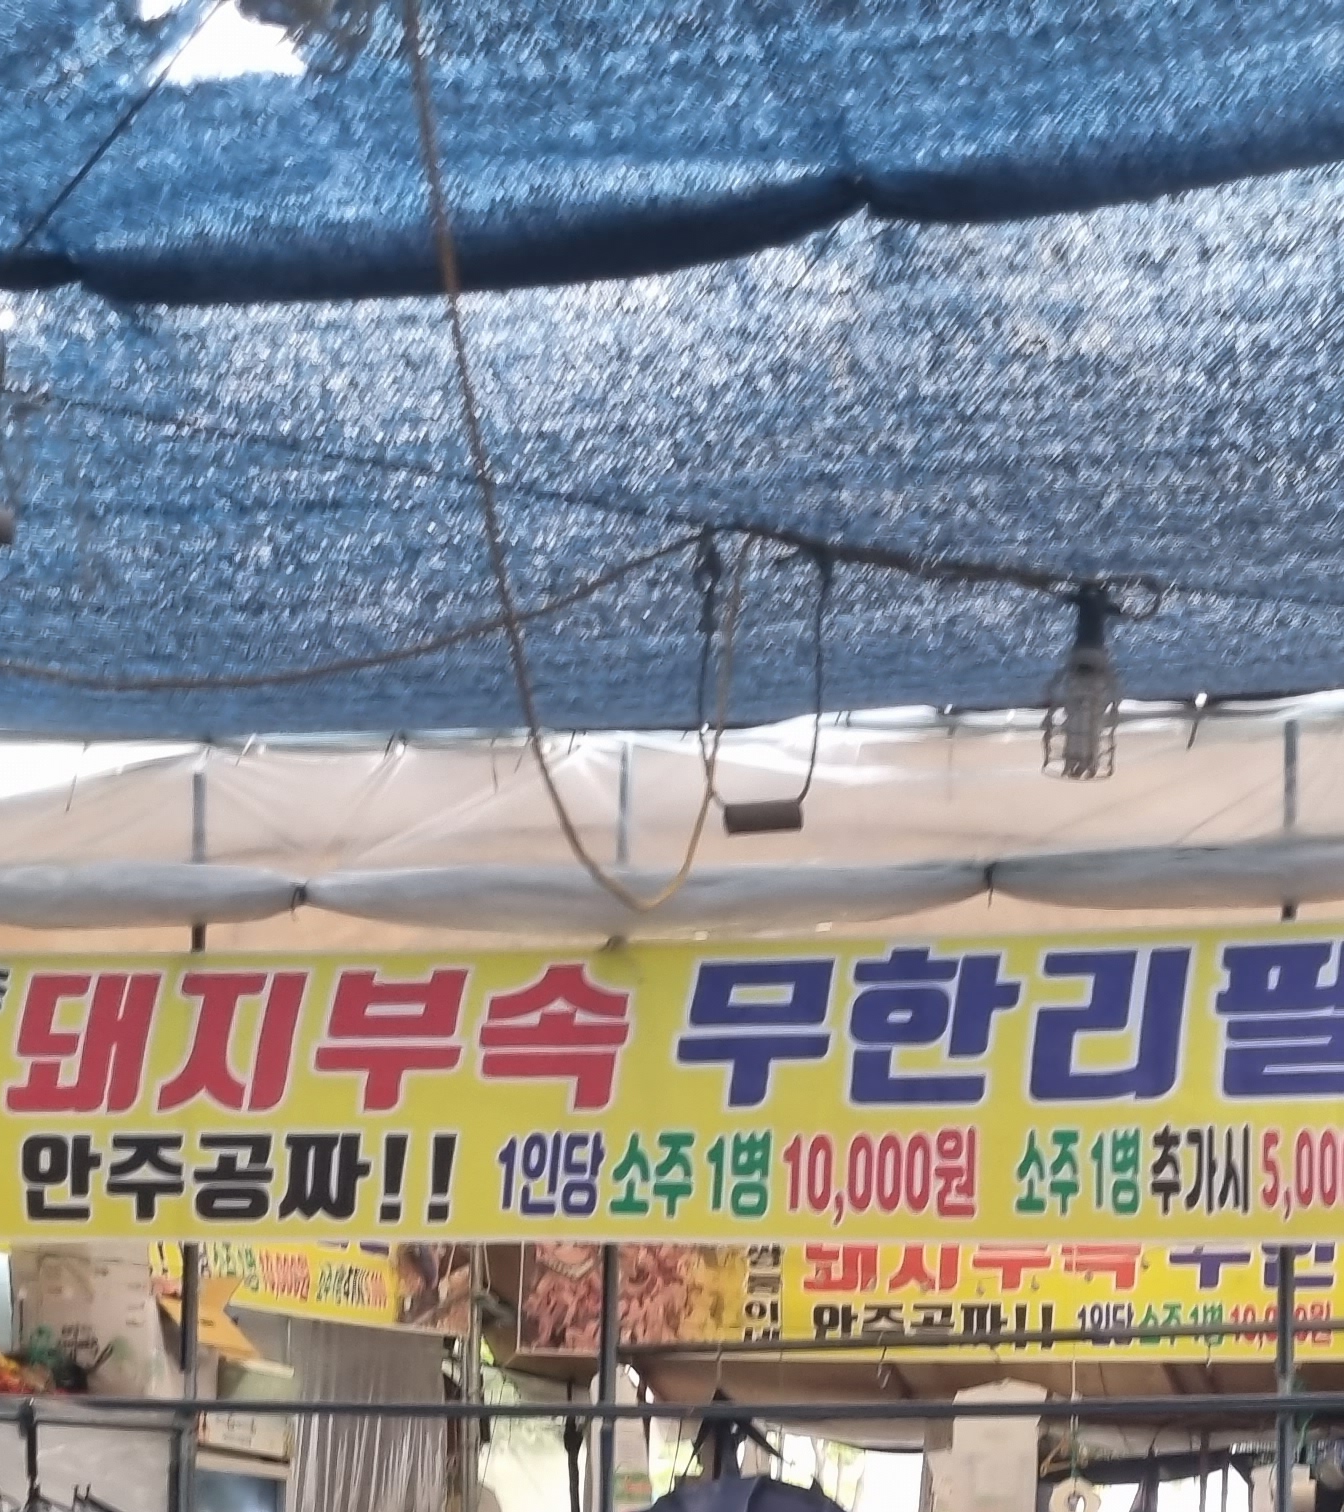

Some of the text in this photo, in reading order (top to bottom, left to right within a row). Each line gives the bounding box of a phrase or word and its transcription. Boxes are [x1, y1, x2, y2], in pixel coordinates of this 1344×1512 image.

[6, 963, 630, 1114] 돼지부속
[21, 1132, 457, 1222] 안주공짜!!
[498, 1130, 605, 1217] 1인당
[609, 1130, 695, 1219] 소주
[707, 1128, 771, 1217] 1병
[783, 1126, 976, 1227] 10,000원
[1015, 1129, 1080, 1216] 소주
[1091, 1127, 1141, 1215] 1병
[1151, 1123, 1250, 1216] 추가시
